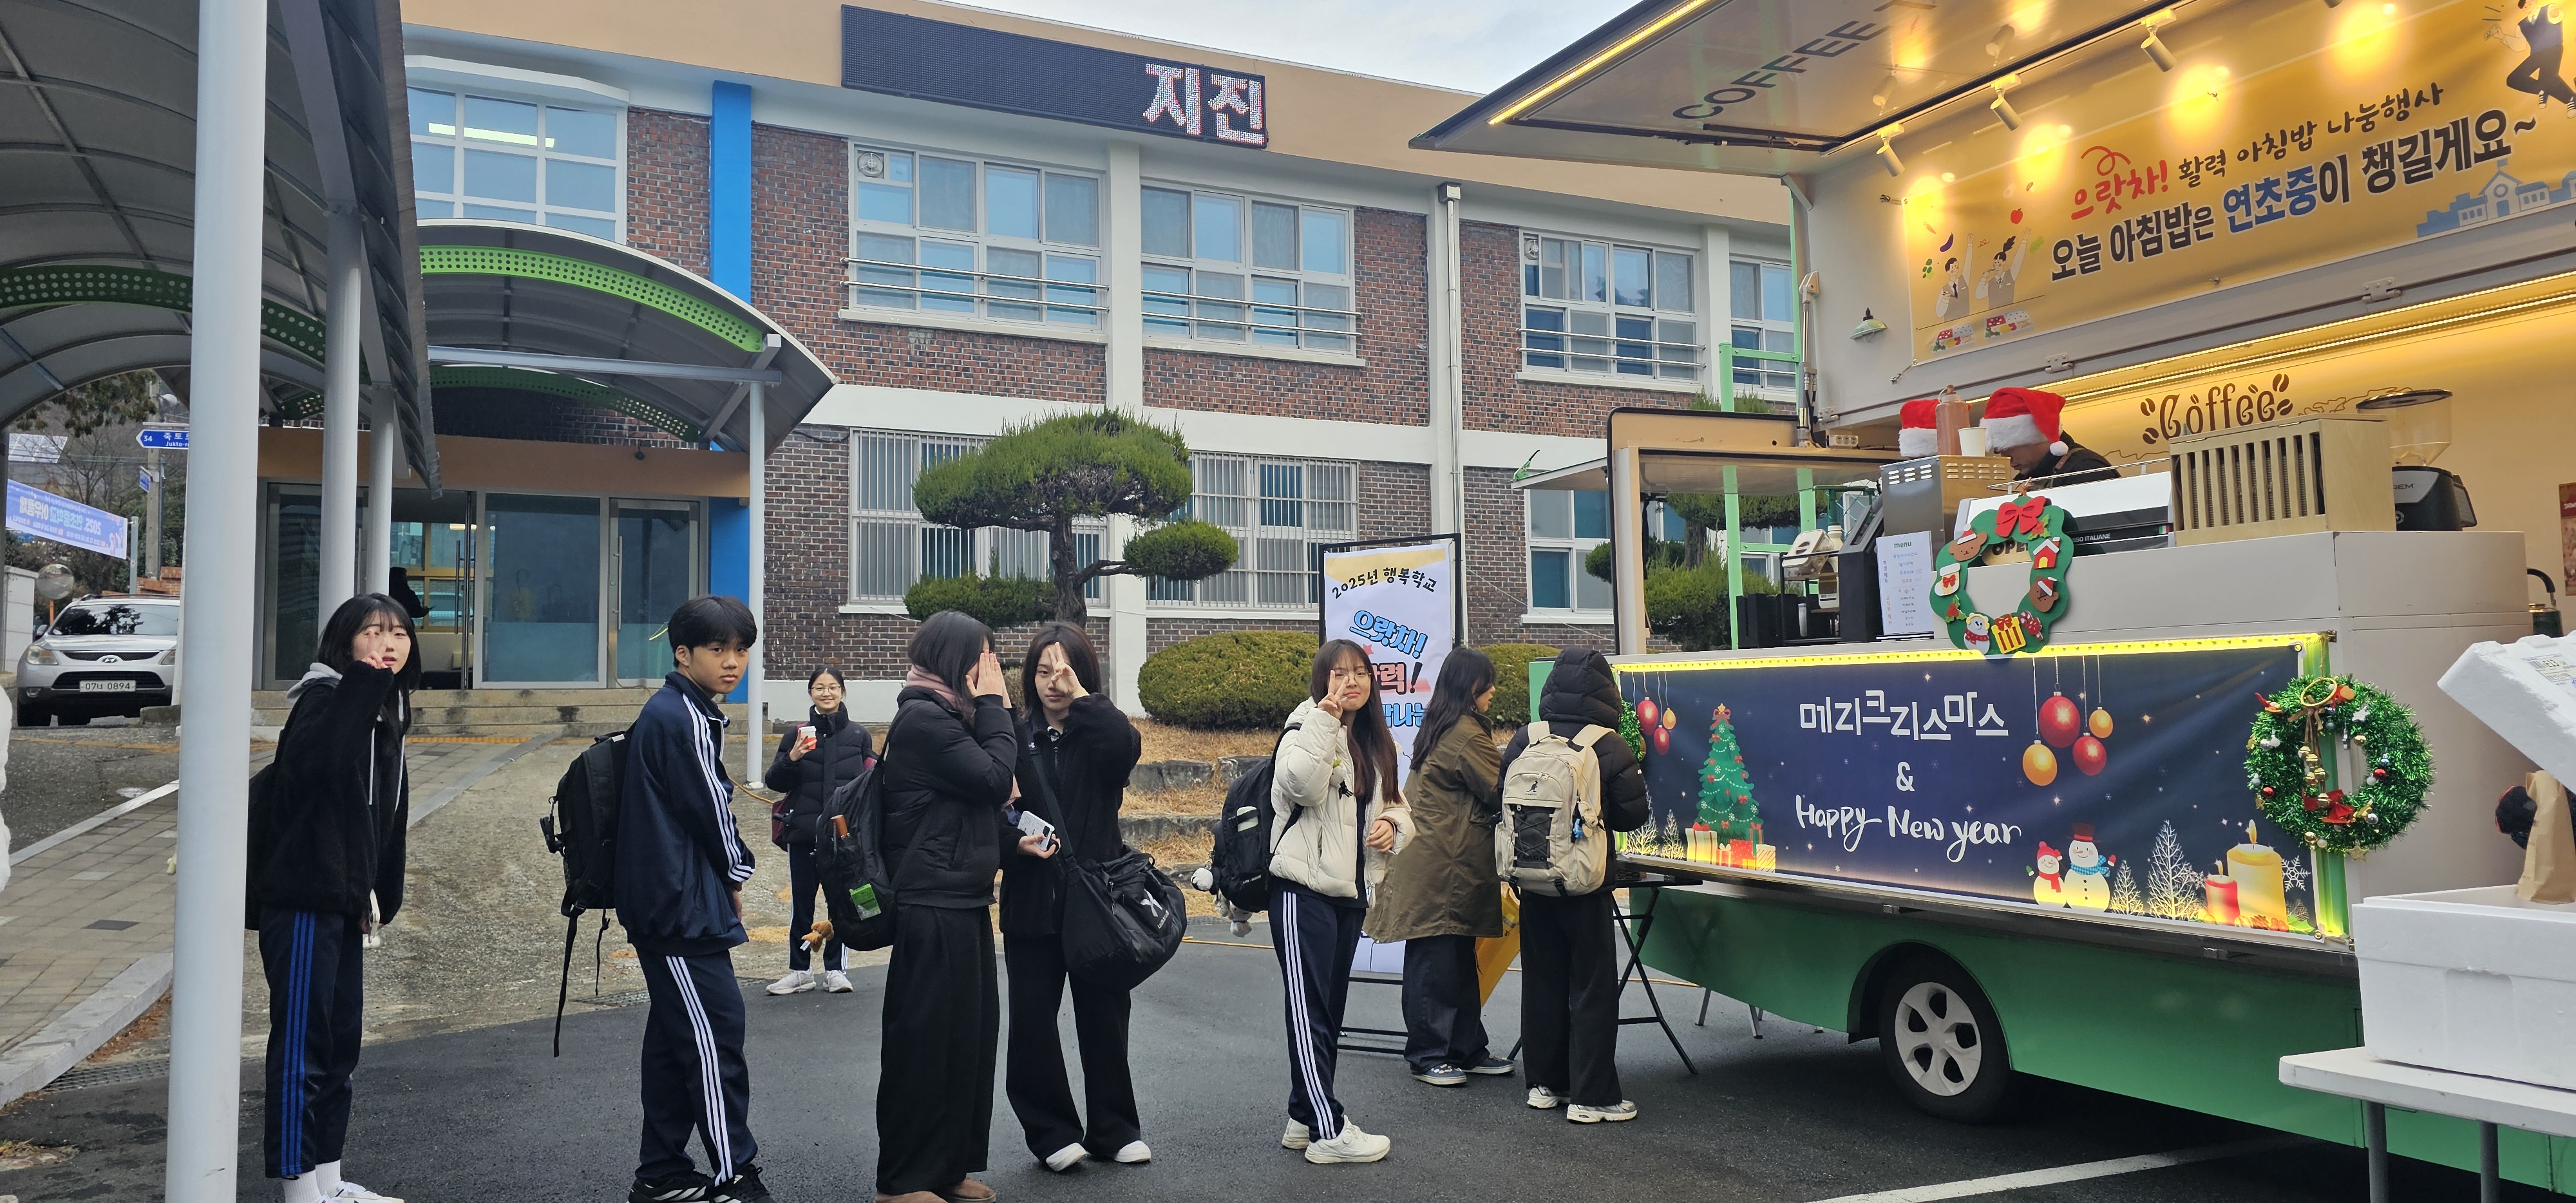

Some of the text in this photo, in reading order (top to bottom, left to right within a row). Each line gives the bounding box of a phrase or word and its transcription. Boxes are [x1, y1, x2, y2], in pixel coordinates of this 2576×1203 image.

[1672, 20, 1891, 120] COFFEE
[1142, 62, 1266, 146] 지진
[2071, 82, 2445, 221] 으랏차! 활력 아침밥 나눔행사
[2050, 231, 2103, 281] 오늘
[2110, 200, 2215, 264] 아침밥은
[2223, 155, 2349, 236] 연초중이
[2159, 383, 2275, 440] Coffee
[1992, 542, 2028, 556] OPE
[2085, 533, 2111, 542] ITALIANE
[1332, 567, 1437, 599] 2025년 행복학교
[1349, 611, 1428, 658] 으랏차!
[1800, 690, 2009, 741] 메리크리스마스
[1895, 763, 1915, 792] &
[1795, 794, 2022, 864] Happy New year
